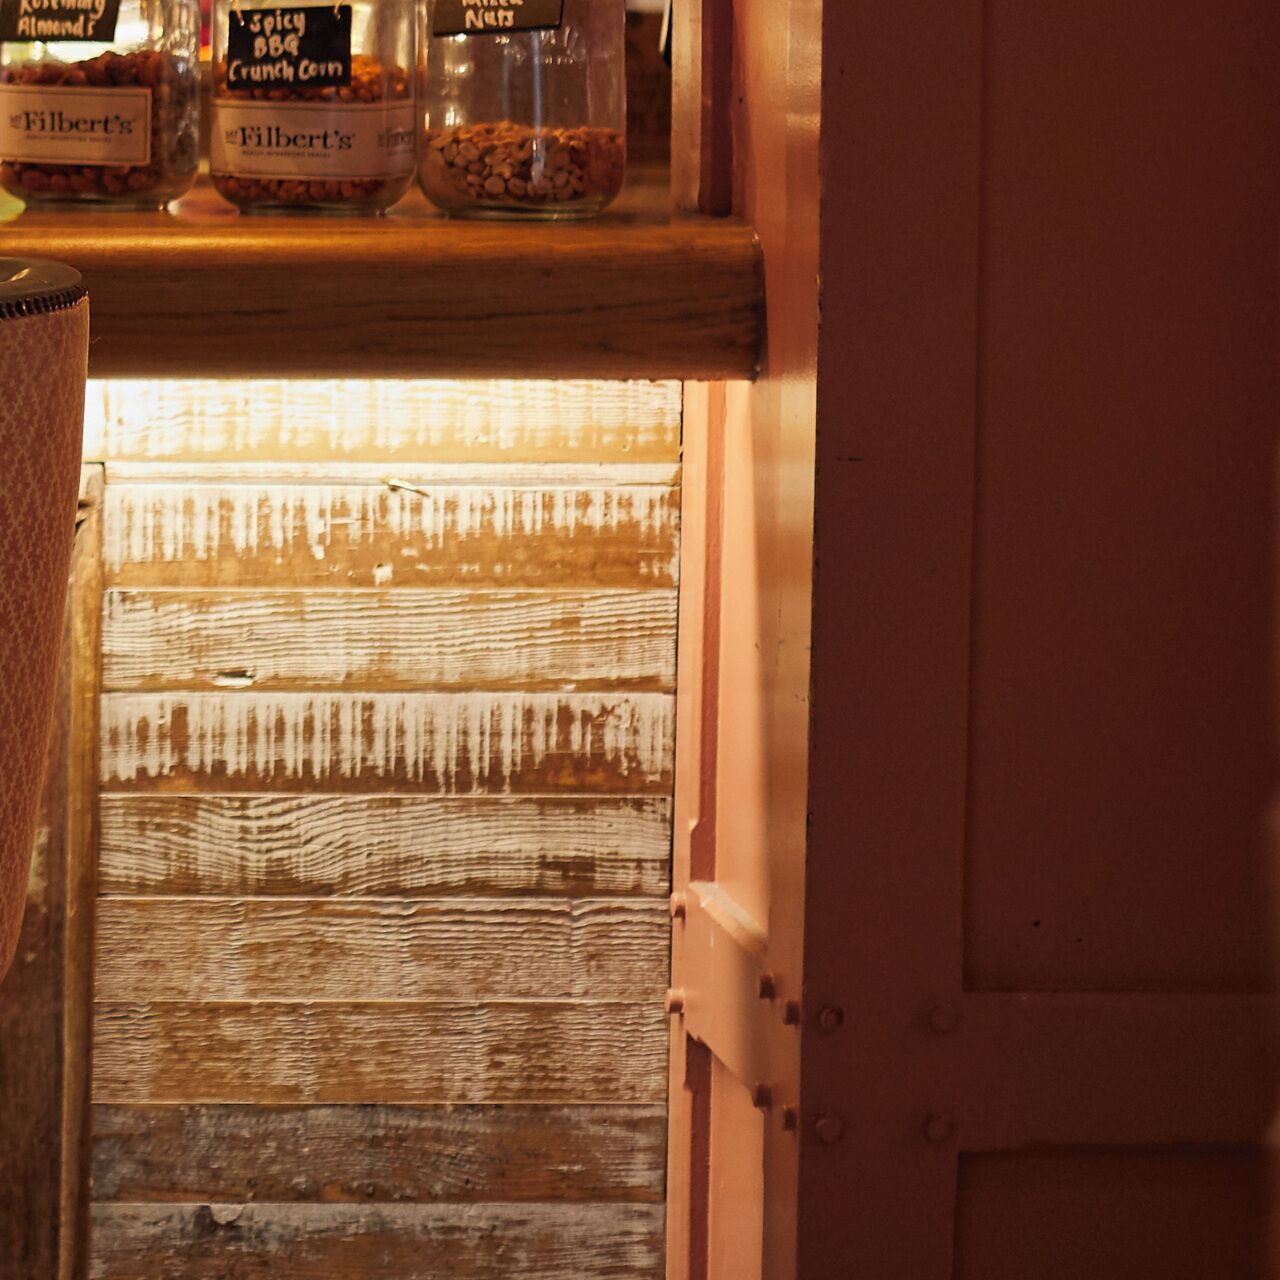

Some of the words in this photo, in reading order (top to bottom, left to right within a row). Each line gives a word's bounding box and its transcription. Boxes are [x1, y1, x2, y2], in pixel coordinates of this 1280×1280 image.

[17, 14, 97, 38] Almonds
[249, 9, 306, 37] Spicy
[465, 8, 515, 29] Nuts
[254, 33, 300, 58] BBQ
[229, 59, 295, 82] Crunch
[298, 58, 343, 81] Corn
[23, 111, 134, 135] Filbert's
[239, 125, 354, 150] Filbert's
